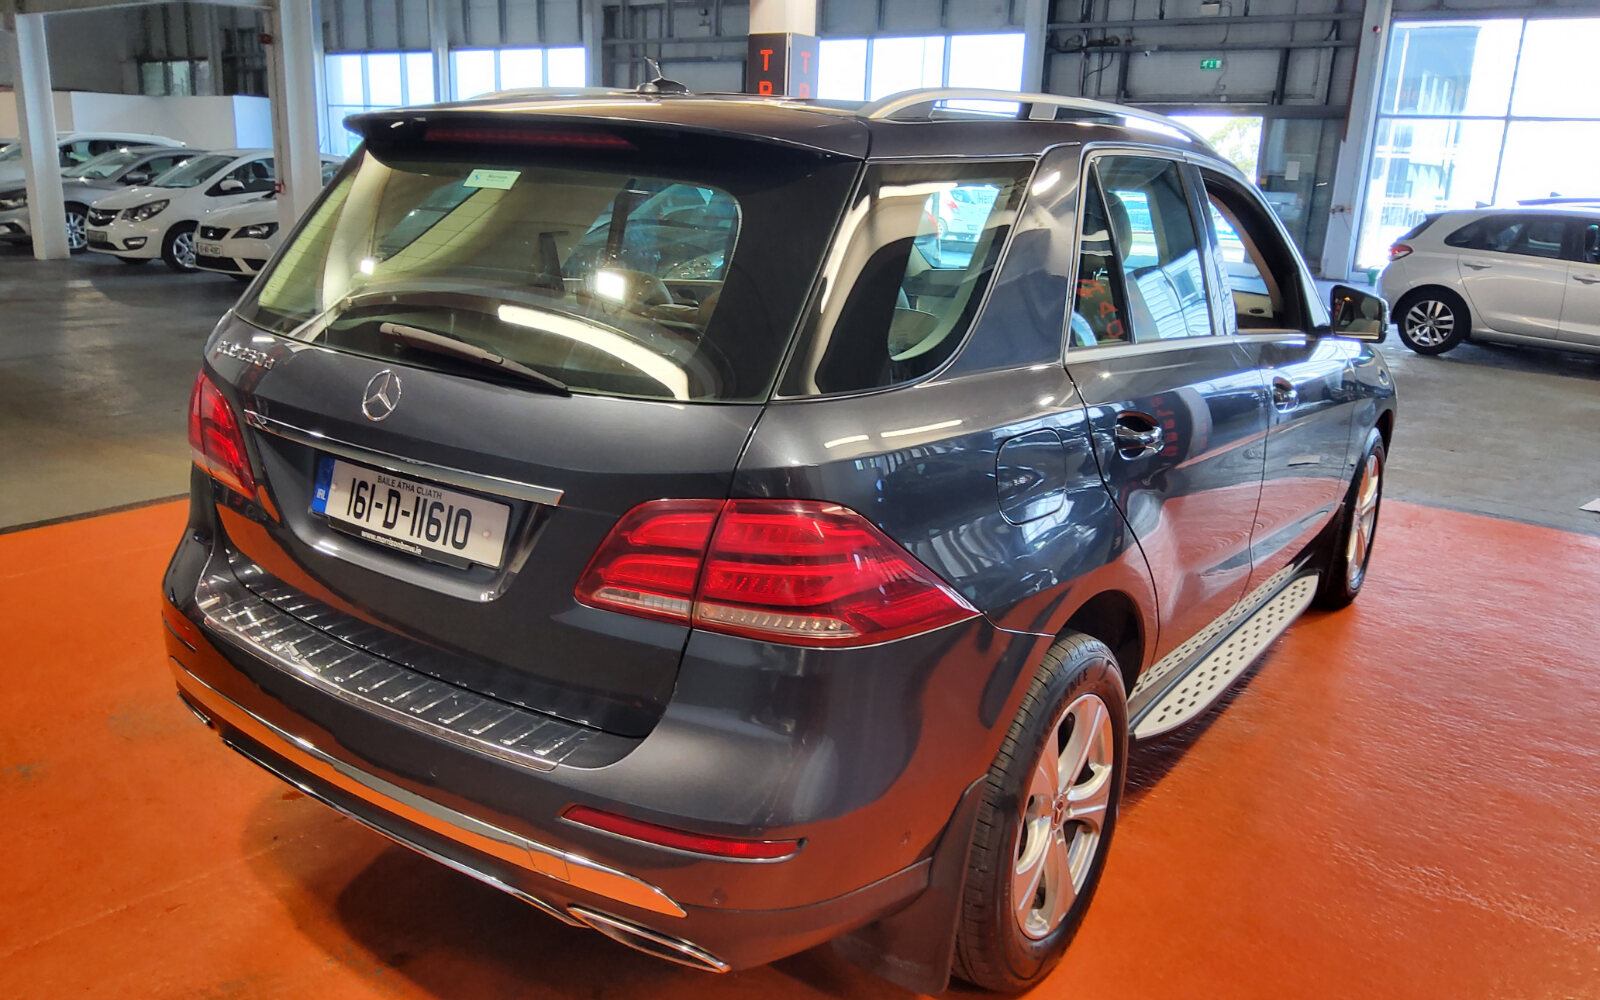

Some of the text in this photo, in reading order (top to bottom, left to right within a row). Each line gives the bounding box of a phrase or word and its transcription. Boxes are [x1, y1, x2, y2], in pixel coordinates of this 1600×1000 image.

[377, 475, 396, 488] BAILE
[416, 486, 443, 500] CLIATH
[347, 478, 472, 550] 161-D-11610
